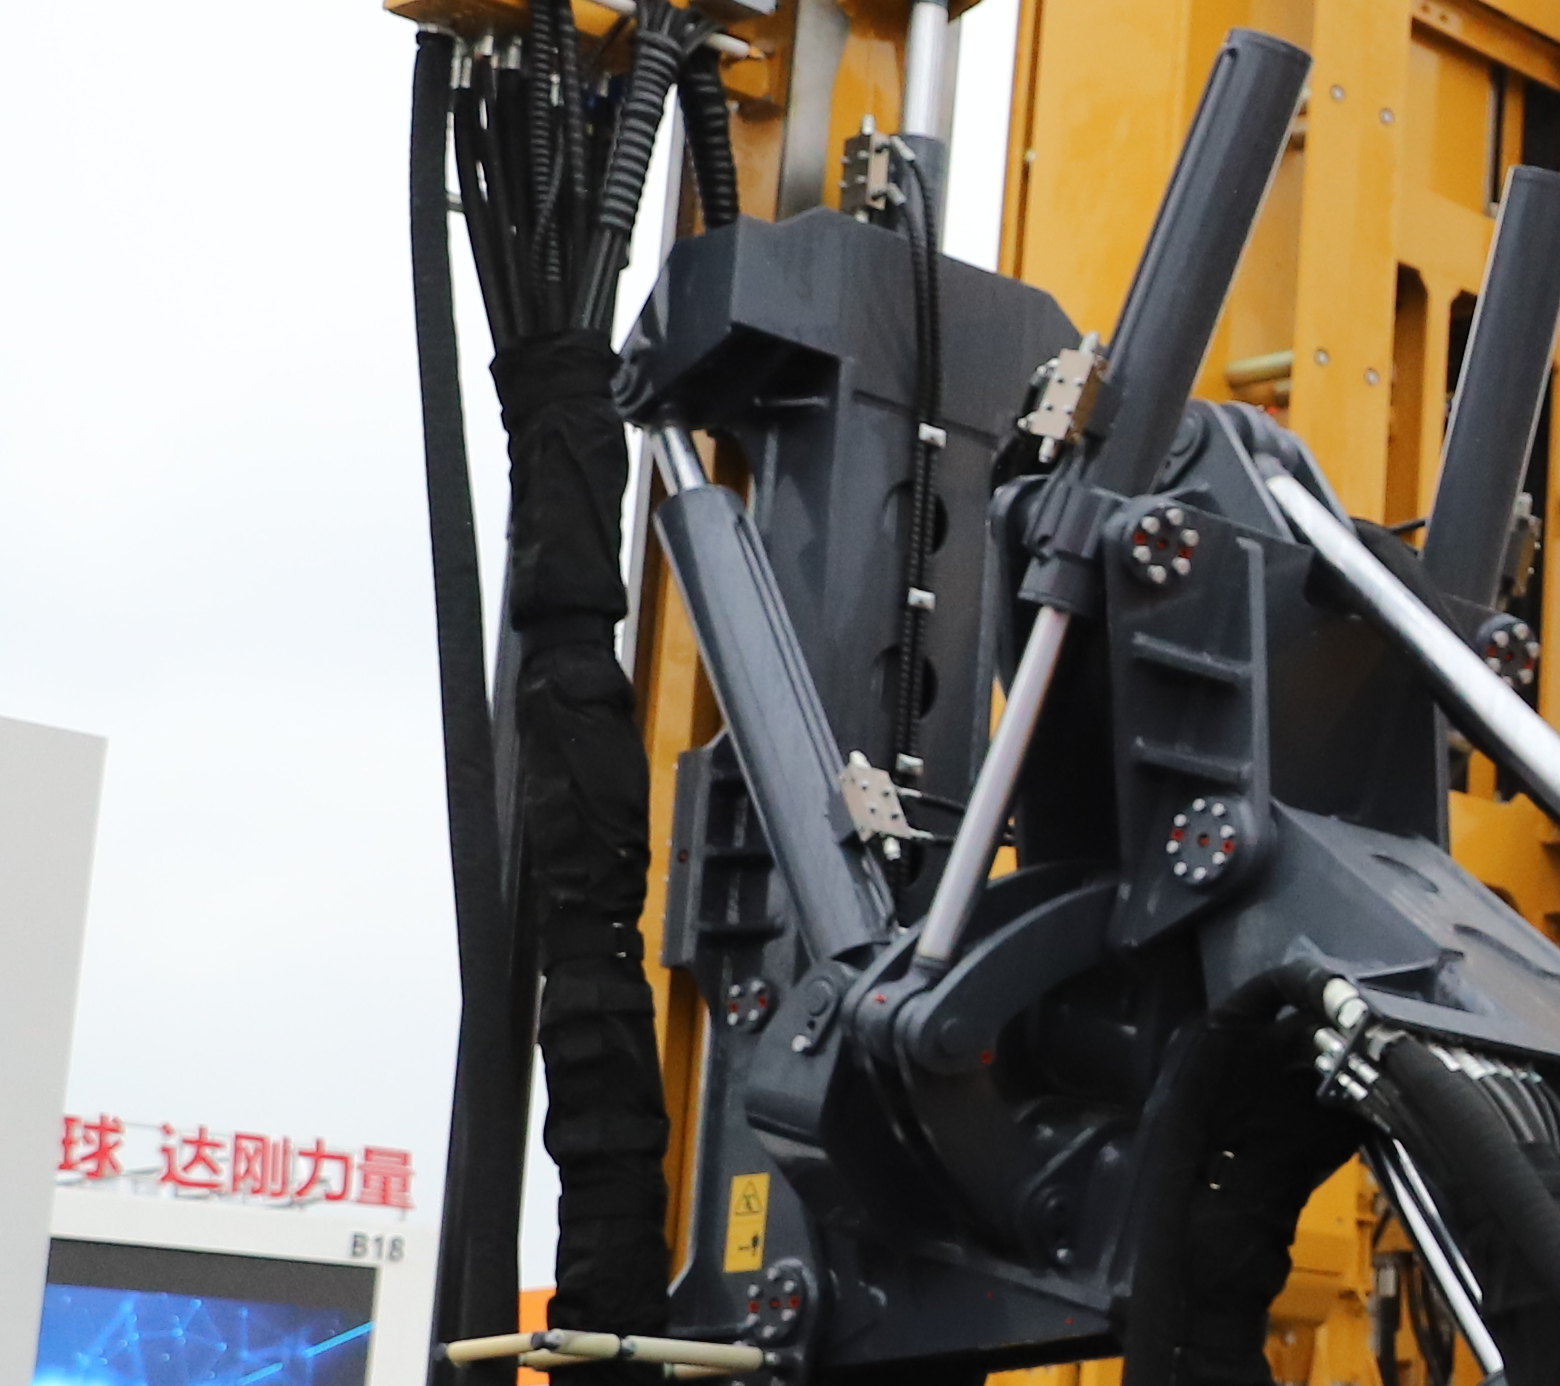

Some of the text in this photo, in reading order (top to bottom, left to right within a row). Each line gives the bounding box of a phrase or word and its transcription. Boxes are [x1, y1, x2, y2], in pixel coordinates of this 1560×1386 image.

[58, 1111, 416, 1210] 球 达刚力量
[350, 1233, 406, 1263] B18
